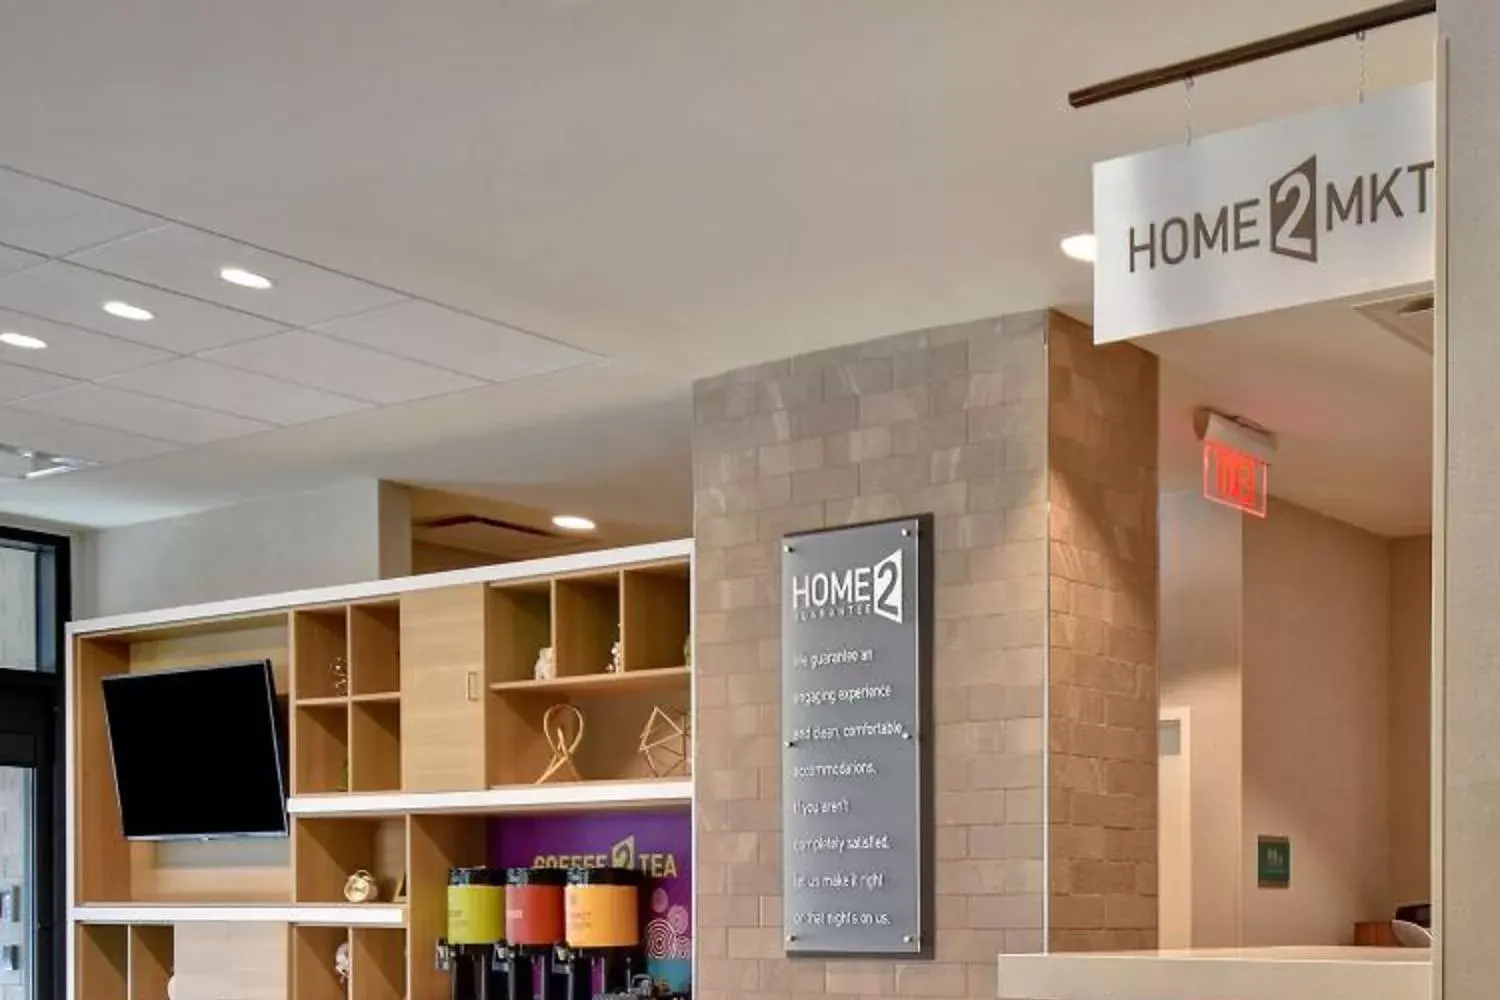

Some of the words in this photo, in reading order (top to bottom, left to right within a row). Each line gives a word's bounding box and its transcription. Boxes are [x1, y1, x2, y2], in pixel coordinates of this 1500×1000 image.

[1129, 198, 1260, 272] HOME
[1326, 160, 1434, 231] MKT
[793, 567, 870, 608] HOME
[639, 853, 677, 878] TEA
